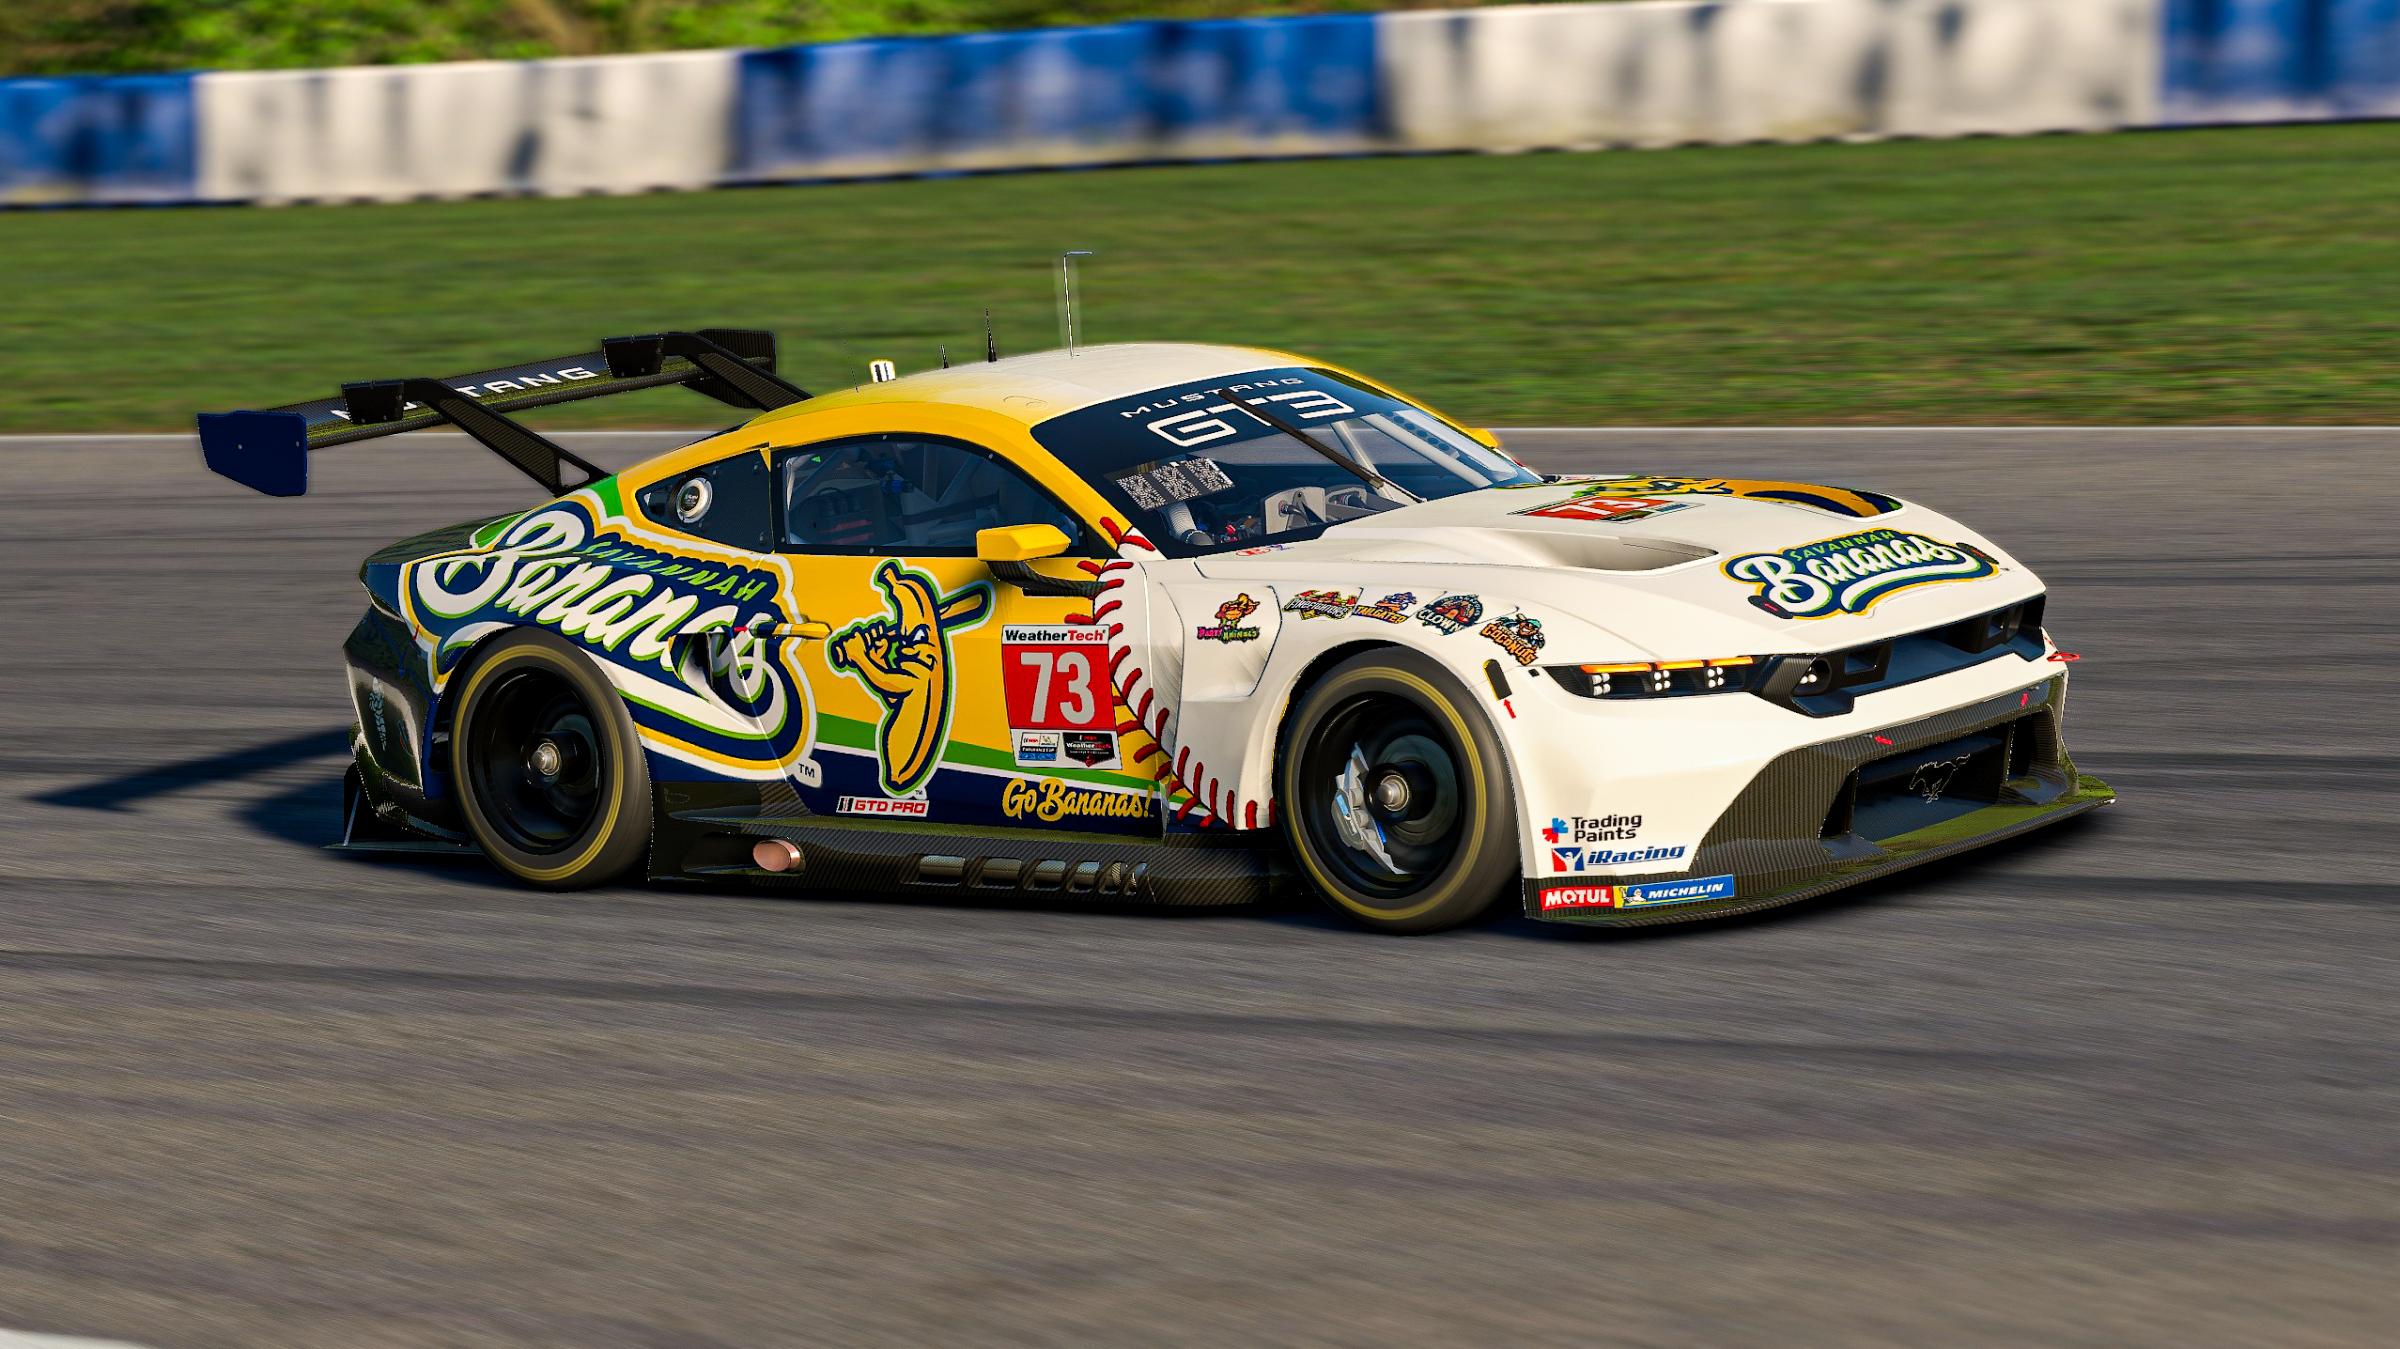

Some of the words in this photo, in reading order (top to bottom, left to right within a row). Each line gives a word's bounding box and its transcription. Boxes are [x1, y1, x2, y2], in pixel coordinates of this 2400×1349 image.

[1120, 377, 1304, 419] MUSTANG
[1147, 390, 1355, 447] GT3
[1546, 500, 1649, 516] 73
[1789, 530, 1895, 562] SAVANNAH
[576, 541, 767, 601] SAVANNAH
[1733, 535, 1957, 613] Bananas
[417, 509, 779, 703] Bananas
[1418, 609, 1464, 632] CLOWN
[1005, 629, 1104, 641] WeatherTech
[1020, 651, 1095, 725] 73
[798, 763, 815, 778] TM
[854, 799, 889, 812] GTD
[891, 801, 926, 814] PRO
[1002, 778, 1037, 820] Go
[1036, 777, 1154, 821] Bananas!
[1571, 814, 1642, 830] Trading
[1574, 827, 1637, 843] Paints
[1587, 845, 1687, 865] iRacing
[1545, 888, 1610, 907] MOTUL
[1648, 883, 1724, 899] MICHELIN
